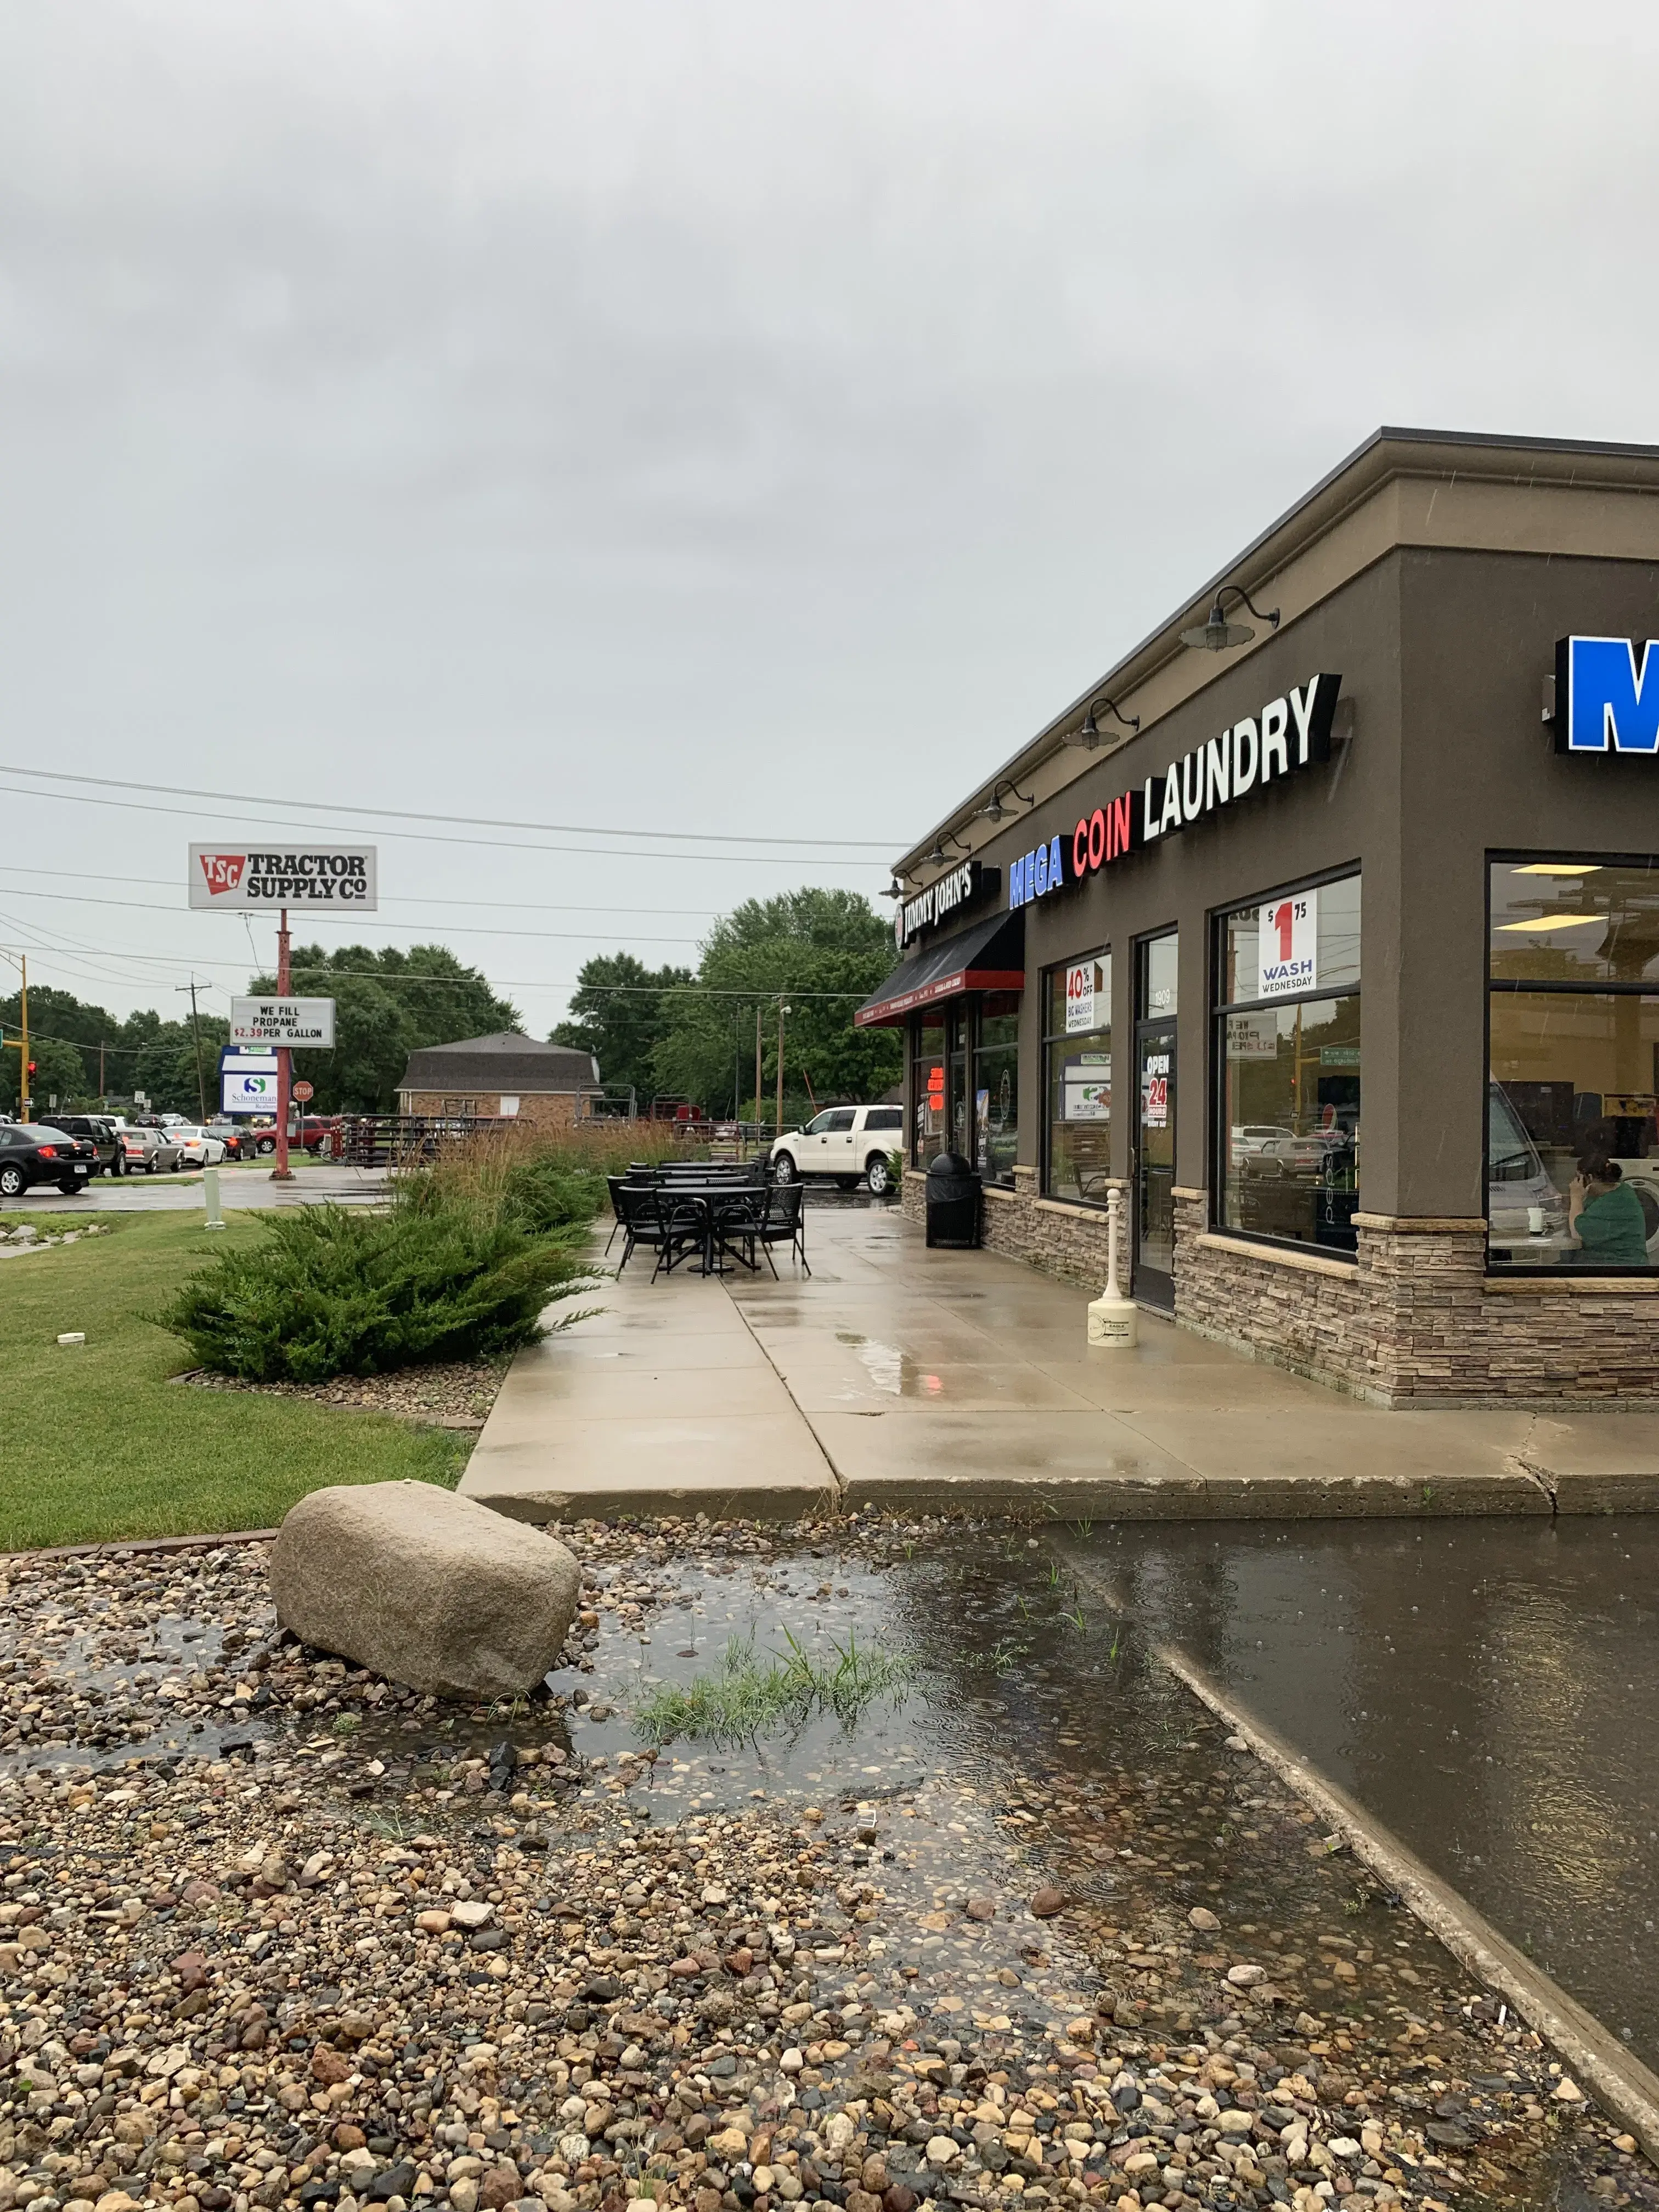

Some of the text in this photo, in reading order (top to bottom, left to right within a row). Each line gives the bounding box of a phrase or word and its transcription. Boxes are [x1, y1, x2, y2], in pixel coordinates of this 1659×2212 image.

[1009, 674, 1321, 910] MEGA COIN LAUNDRY
[205, 856, 238, 888] TSC
[247, 854, 366, 876] TRACTOR
[247, 877, 337, 899] SUPPLY
[904, 861, 972, 944] JIMMY JOHN'S
[1263, 960, 1312, 980] WASH
[1083, 985, 1092, 997] OFF
[1262, 976, 1312, 992] WEDNESDAY
[1155, 989, 1170, 1005] 1909
[260, 1006, 300, 1015] WE FILL
[1075, 1001, 1092, 1015] WASHERS
[253, 1017, 297, 1026] PROPANE
[1068, 1016, 1092, 1028] WEDNESDAY
[234, 1028, 322, 1038] $2.39 PER GALLON
[1147, 1054, 1169, 1075] OPEN
[232, 1093, 276, 1102] Schoneman
[1149, 1077, 1167, 1105] 24
[1148, 1107, 1165, 1116] HOURS
